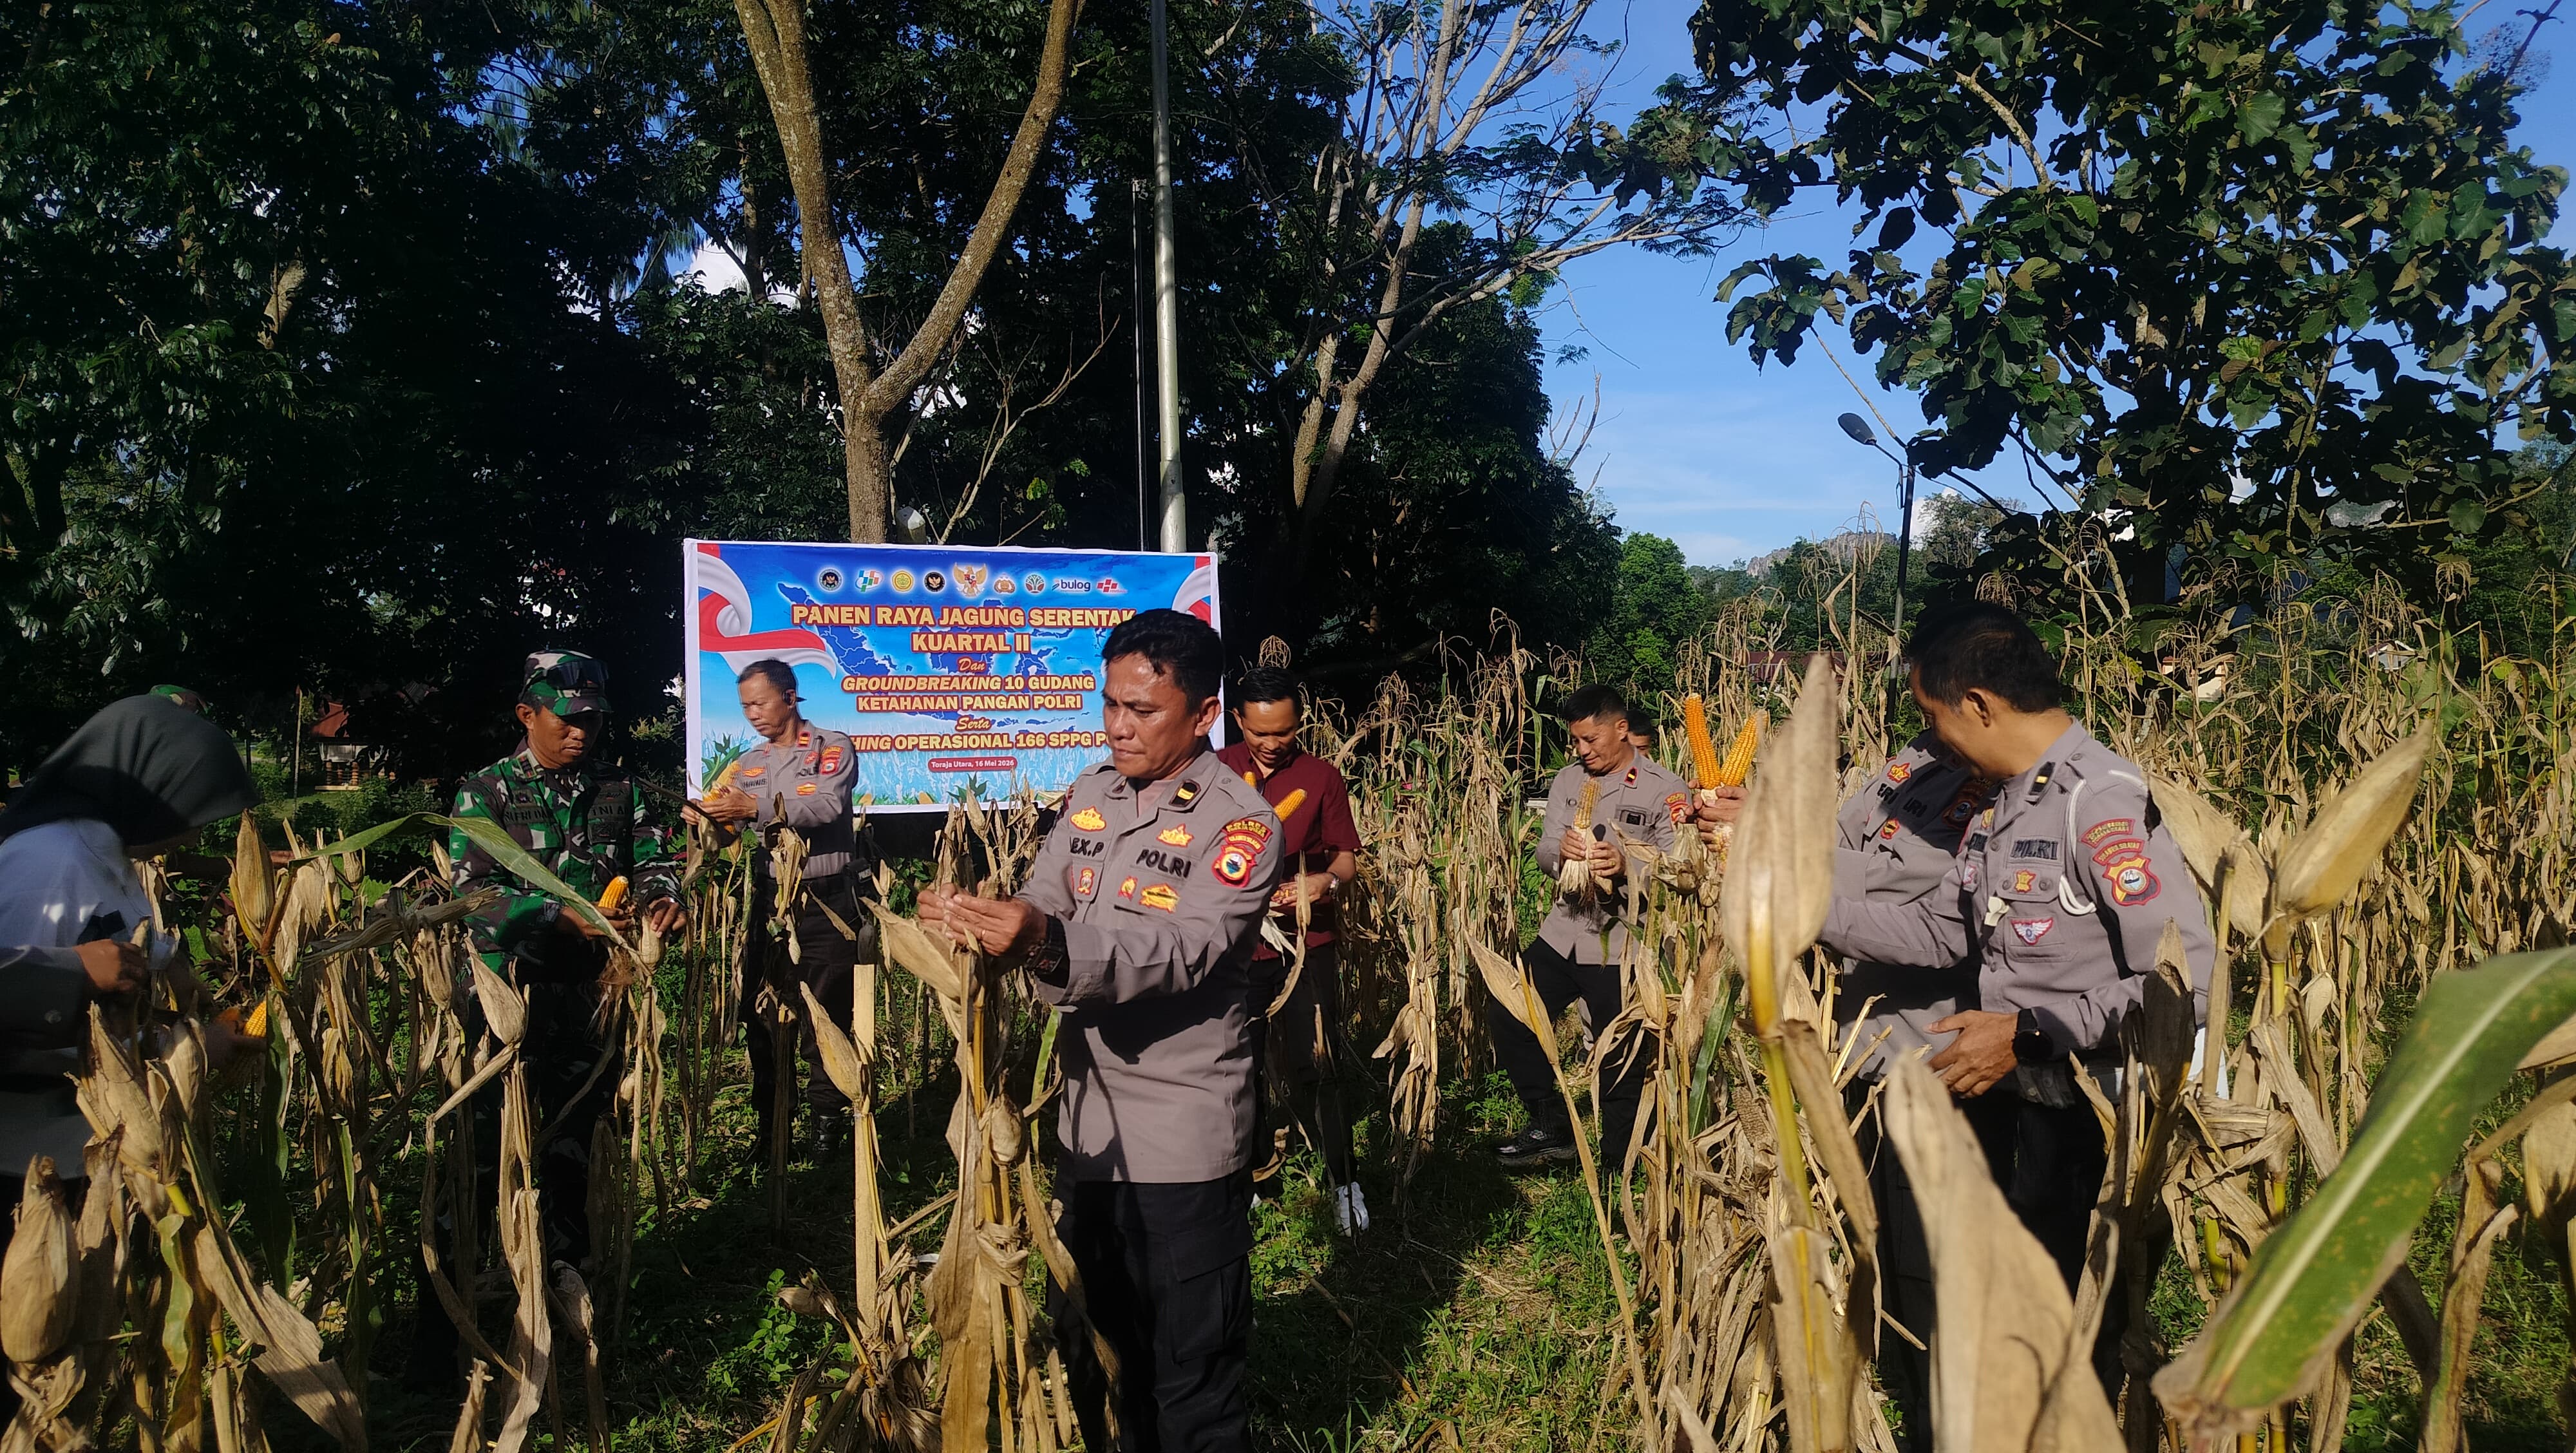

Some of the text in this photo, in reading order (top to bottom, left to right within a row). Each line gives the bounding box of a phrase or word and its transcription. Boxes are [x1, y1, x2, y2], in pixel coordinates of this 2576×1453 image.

[1061, 579, 1091, 592] bulog
[792, 605, 1136, 627] PANEN RAYA JAGUNG SERENTAK
[912, 634, 1030, 651] KUARTAL II
[958, 658, 985, 671] Dan
[842, 676, 1094, 691] GROUNDBREAKING 10 GUDANG
[858, 695, 1081, 710] KETAHANAN PANGAN POLRI
[956, 717, 990, 730] Serta
[850, 736, 892, 750] HING
[895, 734, 1012, 750] OPERASIONAL
[1016, 734, 1045, 748] 166
[1048, 733, 1092, 746] SPPG
[1095, 732, 1109, 746] P
[1135, 849, 1192, 878] POLRI
